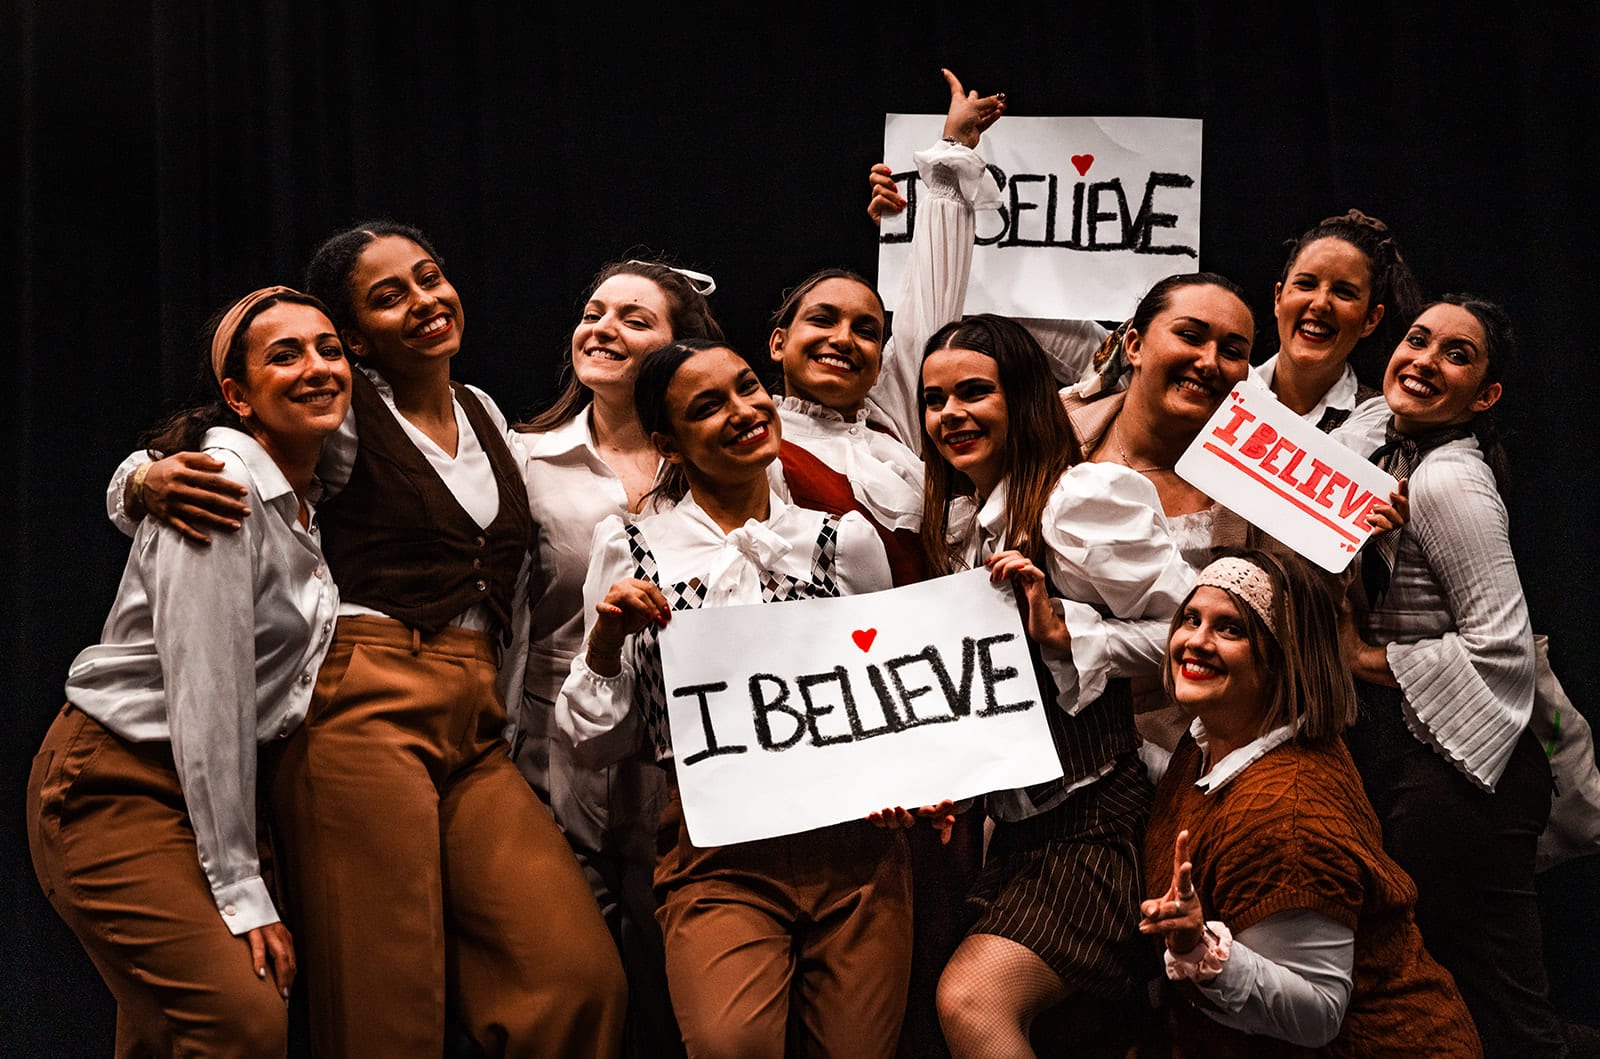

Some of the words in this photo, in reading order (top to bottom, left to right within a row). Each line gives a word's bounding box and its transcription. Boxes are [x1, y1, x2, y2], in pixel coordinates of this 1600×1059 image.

[1212, 405, 1256, 446] I
[1238, 422, 1391, 533] BELIEVE
[673, 681, 748, 766] I
[749, 633, 1036, 752] BELIEVE
